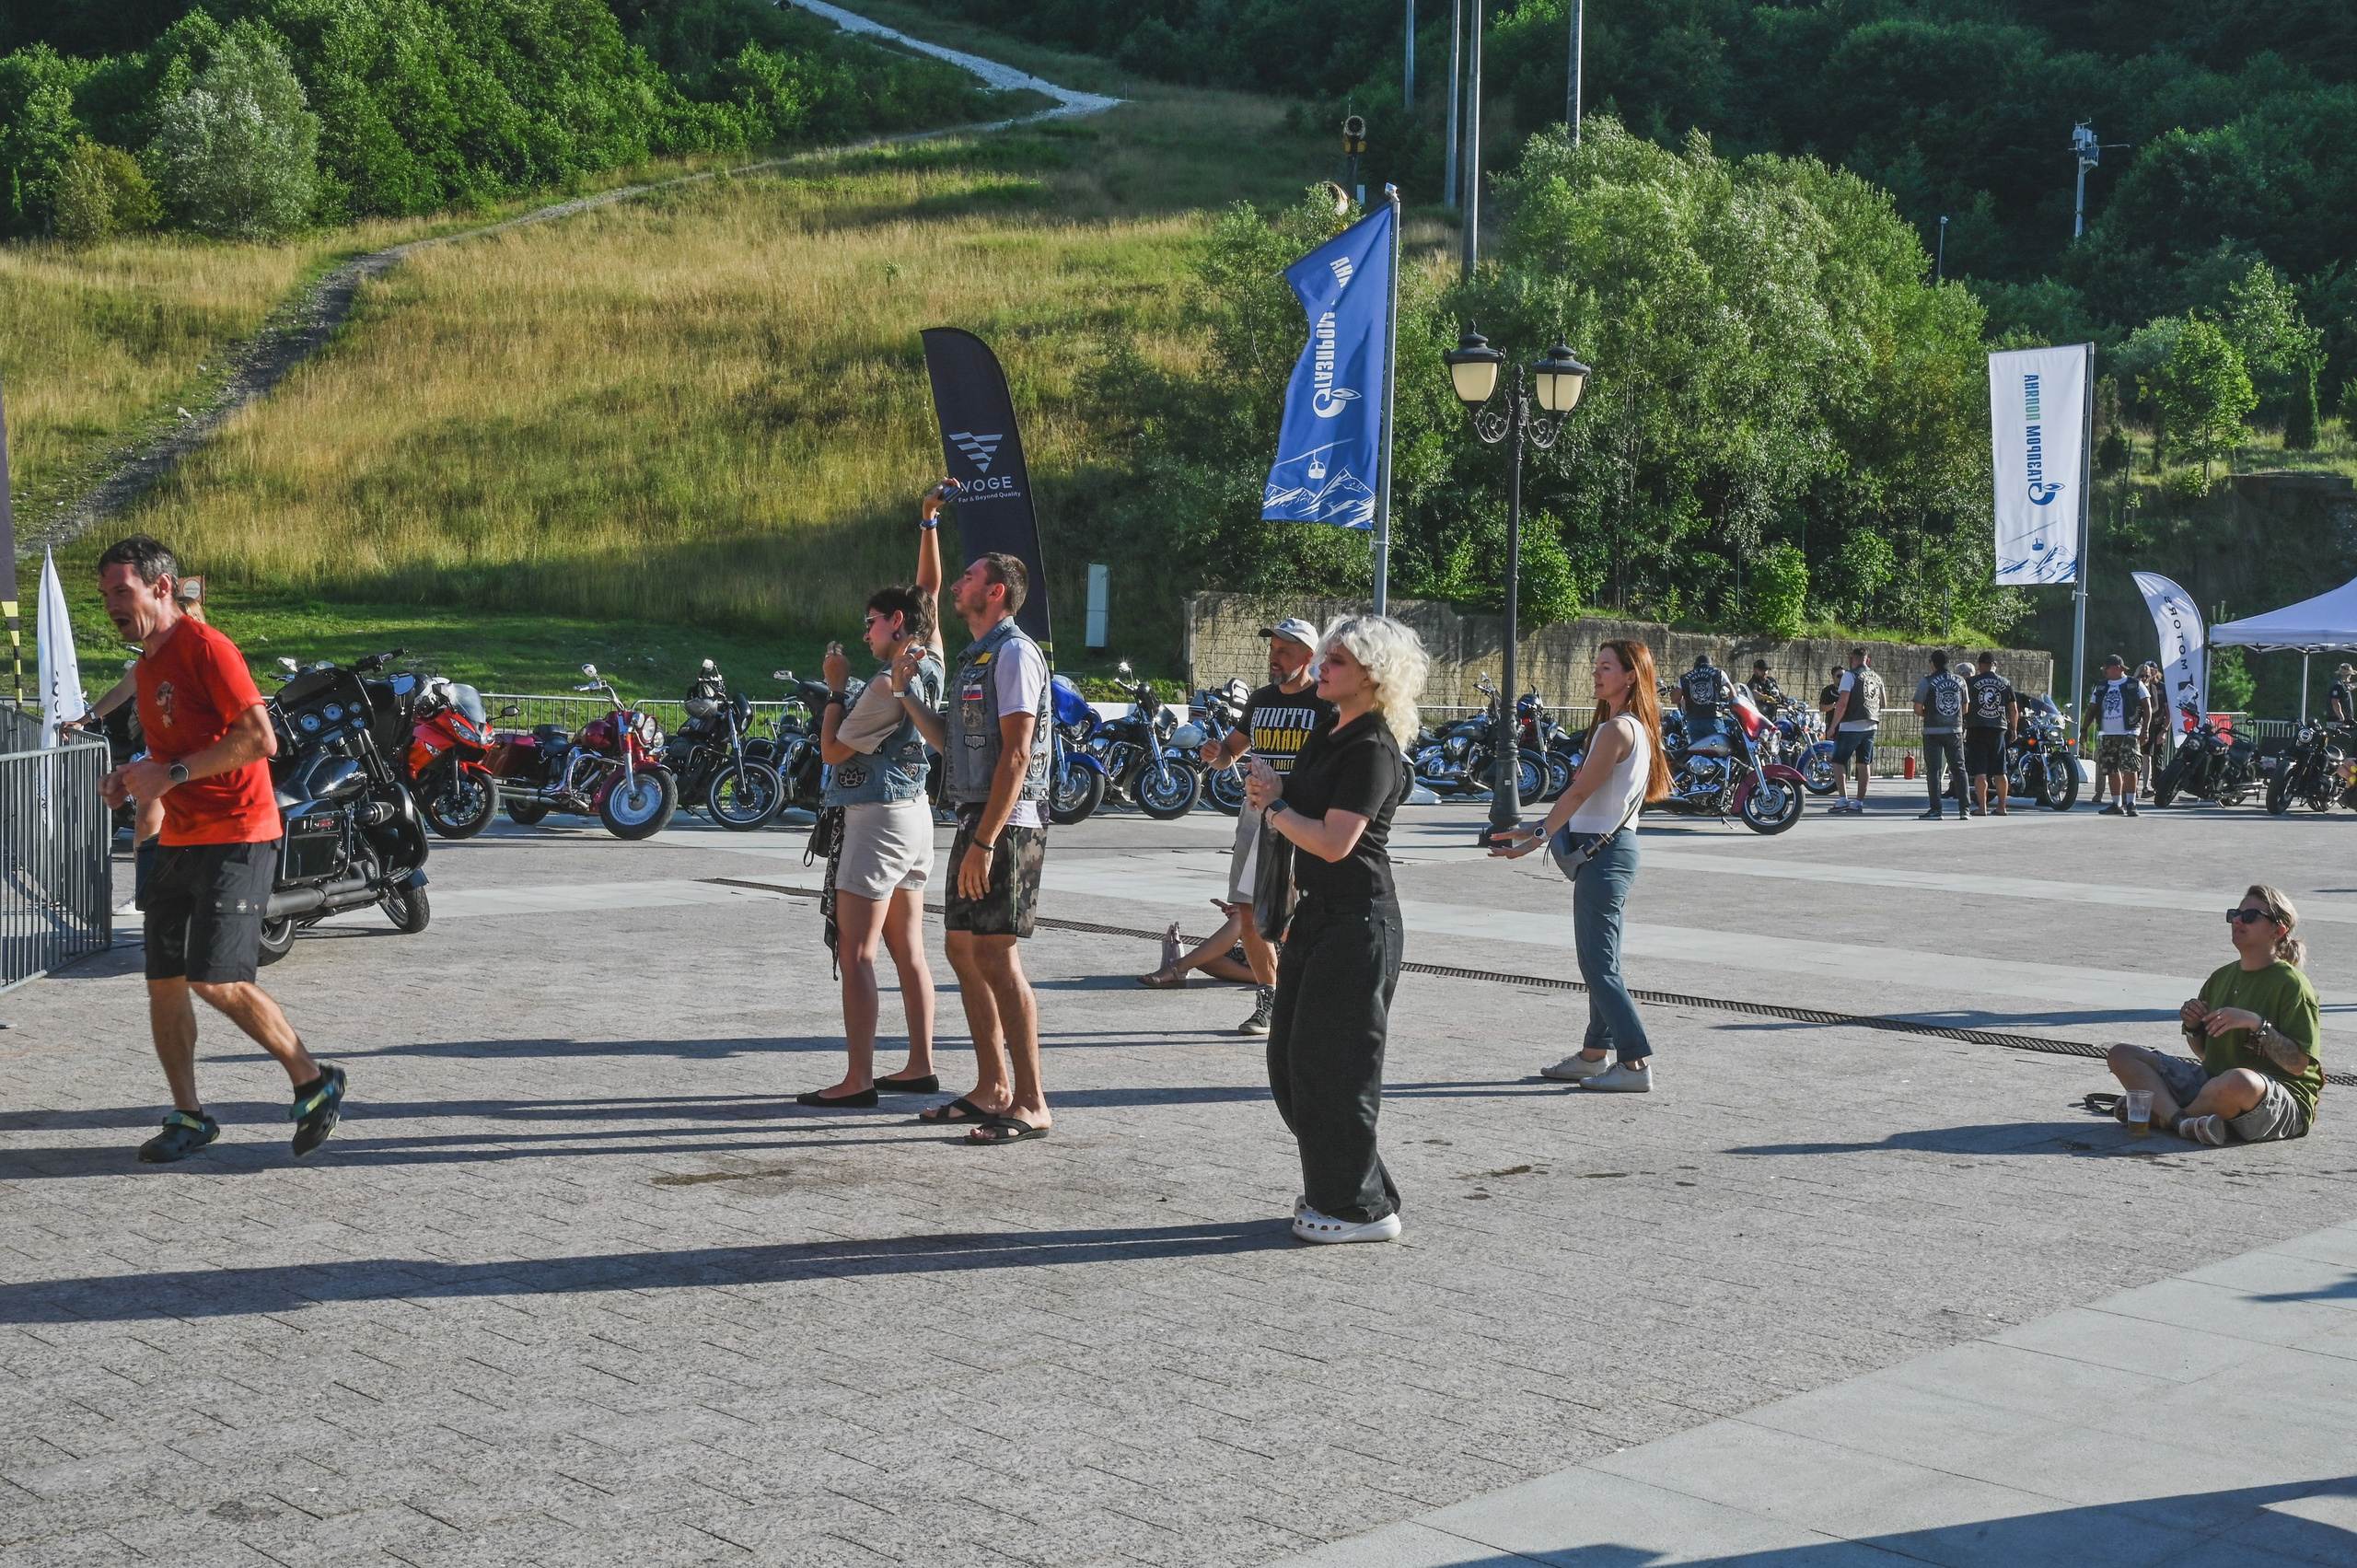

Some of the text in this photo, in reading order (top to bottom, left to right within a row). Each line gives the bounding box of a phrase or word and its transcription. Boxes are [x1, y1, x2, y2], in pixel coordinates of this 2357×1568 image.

[960, 475, 1013, 494] VOGE
[975, 492, 998, 501] Beyond
[1256, 707, 1316, 730] МОТО
